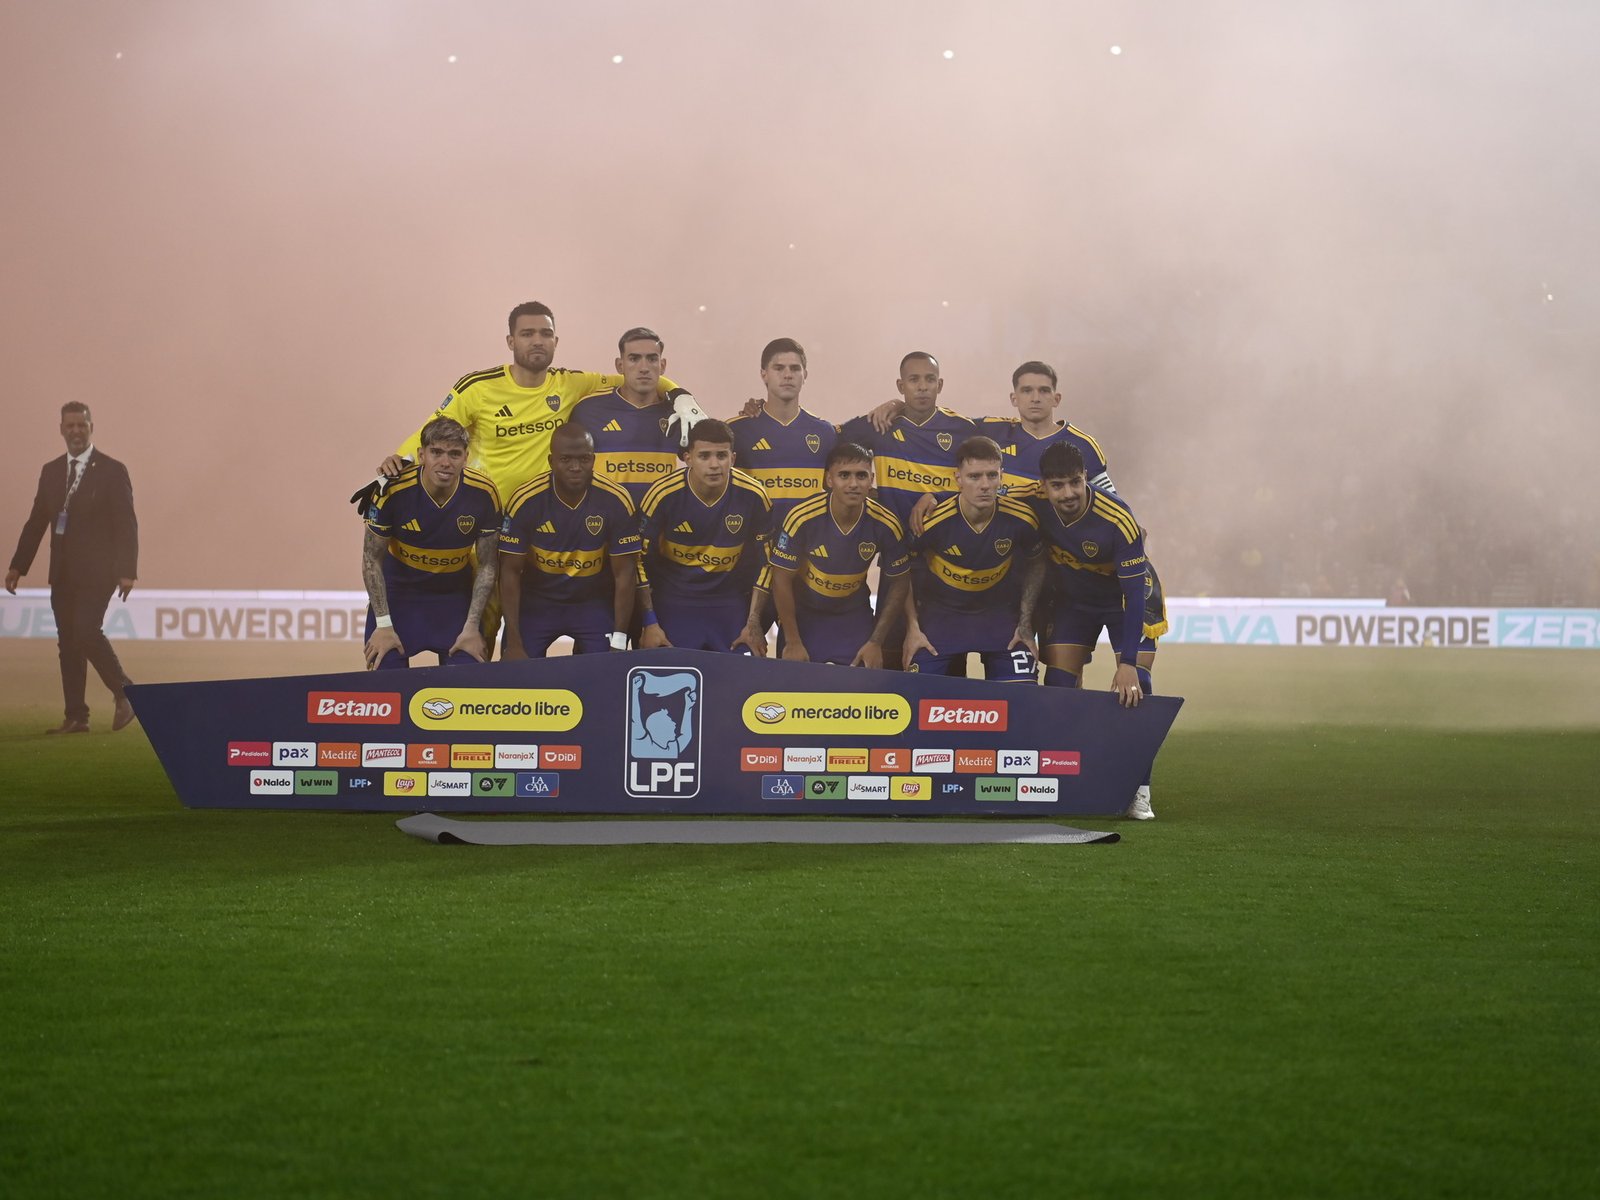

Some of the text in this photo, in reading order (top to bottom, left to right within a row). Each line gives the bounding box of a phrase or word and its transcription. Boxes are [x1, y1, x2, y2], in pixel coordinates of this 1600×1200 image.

[496, 418, 563, 437] betsson
[605, 460, 673, 473] betsson
[888, 465, 951, 487] betsson
[155, 607, 366, 639] POWERADE
[1296, 614, 1491, 645] POWERADE
[1502, 615, 1600, 647] ZER
[317, 698, 392, 717] Betano
[459, 701, 570, 716] mercado libre
[791, 705, 899, 720] mercado libre
[928, 706, 999, 724] Betano
[279, 747, 309, 761] pax
[321, 750, 357, 760] Medifé
[366, 748, 402, 760] MANTECOL
[453, 752, 491, 761] PIRELLI
[558, 753, 577, 762] DiDi
[916, 753, 950, 764] MANTECOL
[759, 755, 778, 764] DiDi
[829, 756, 866, 765] PIRELLI
[958, 756, 993, 767] Medifé
[1003, 755, 1032, 768] pax
[532, 776, 545, 784] LA
[630, 761, 695, 793] LPF
[263, 778, 291, 787] Naldo
[312, 779, 333, 787] WIN
[350, 778, 367, 788] LPF
[777, 778, 790, 787] LA
[525, 783, 549, 793] CAJA
[770, 785, 795, 795] CAJA
[942, 783, 960, 793] LPF
[993, 785, 1011, 793] WIN
[1029, 785, 1056, 794] Naldo
